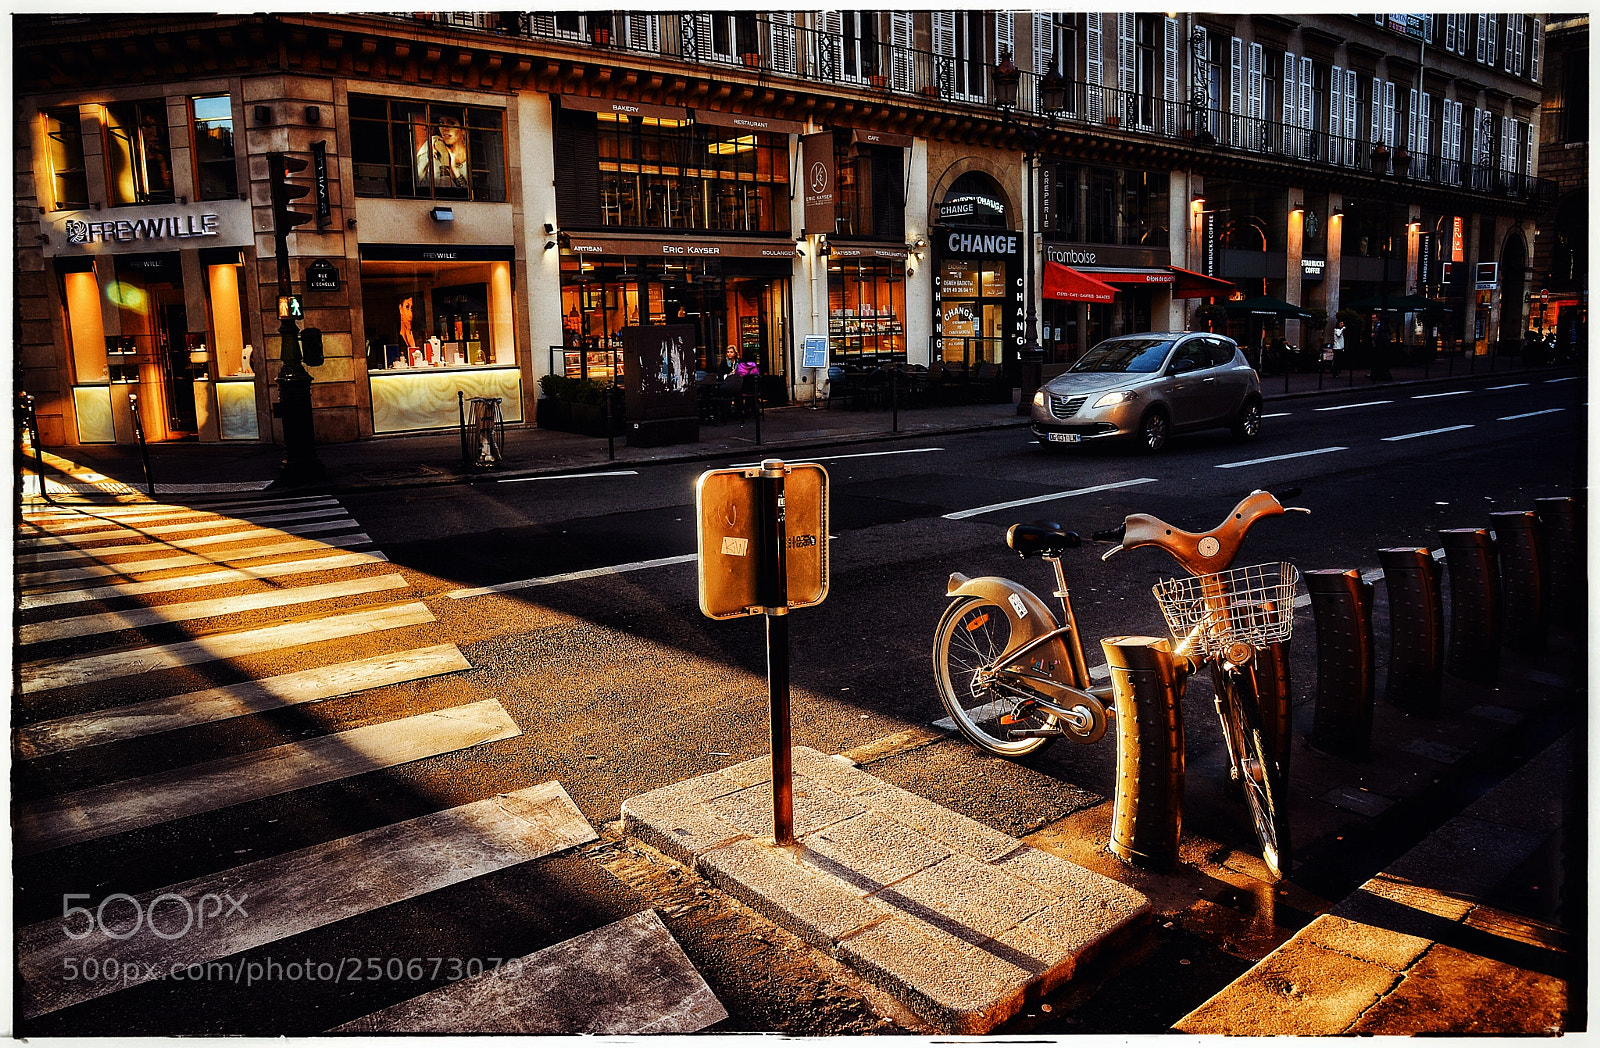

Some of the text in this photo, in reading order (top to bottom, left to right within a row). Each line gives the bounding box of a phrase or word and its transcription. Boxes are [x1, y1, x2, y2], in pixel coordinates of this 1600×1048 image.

[612, 104, 640, 113] BAKERY
[734, 118, 769, 128] RESTAURANT
[940, 203, 974, 215] CHANGE
[87, 214, 219, 243] FREYWILLE
[948, 233, 1017, 254] CHANGE
[573, 245, 603, 253] ARTISAN
[662, 245, 721, 254] ERIC KAYSER
[1047, 246, 1097, 264] framboise
[1301, 259, 1325, 268] STARBUCKS
[1305, 267, 1321, 275] COFFEE
[944, 306, 974, 322] CHANGE
